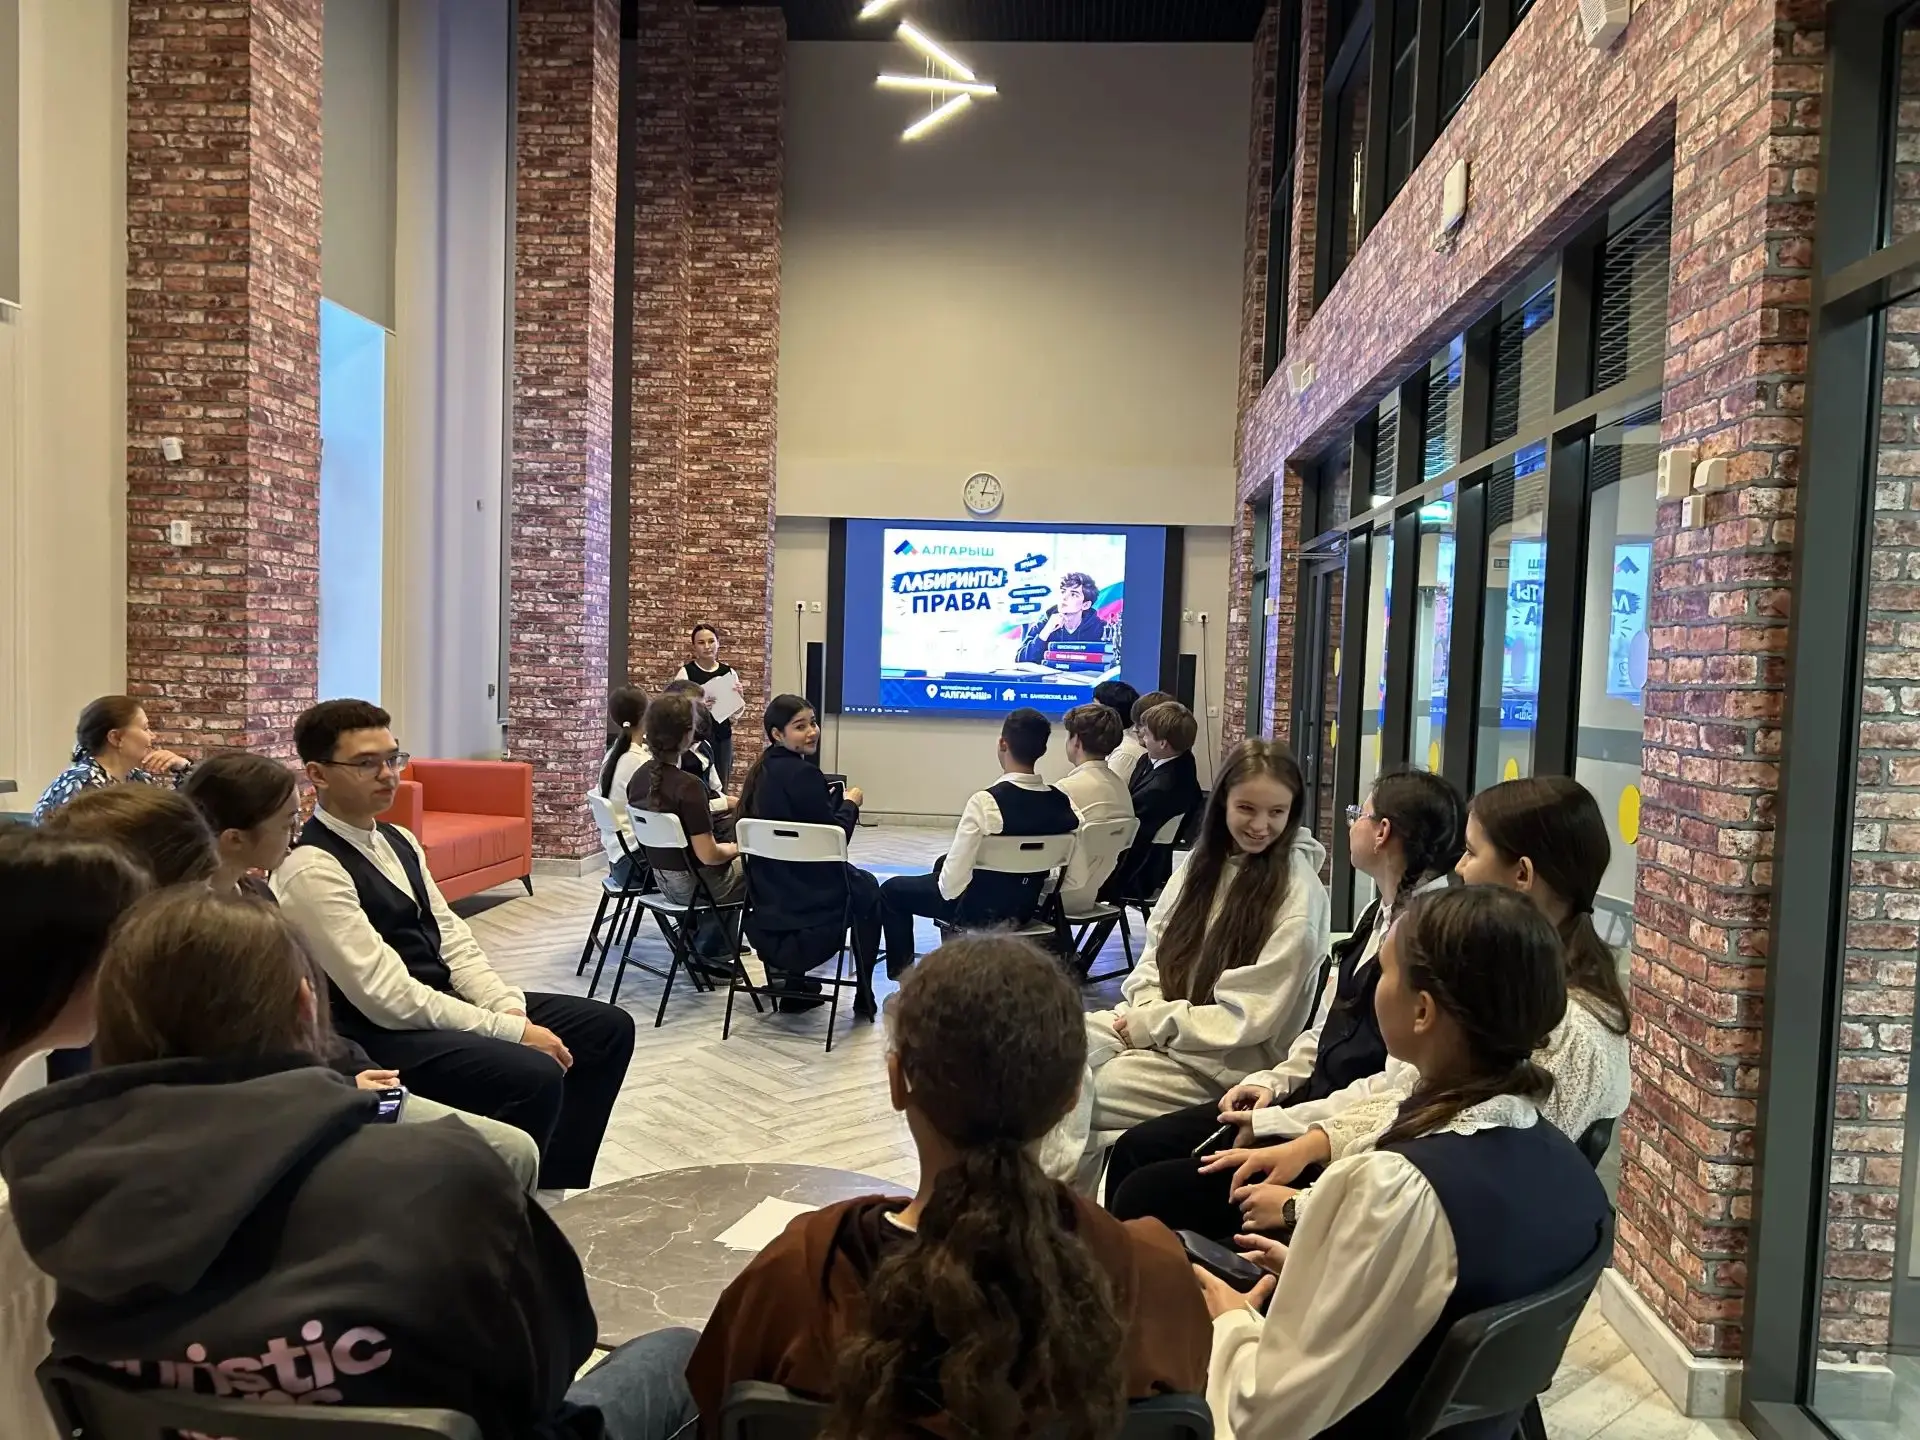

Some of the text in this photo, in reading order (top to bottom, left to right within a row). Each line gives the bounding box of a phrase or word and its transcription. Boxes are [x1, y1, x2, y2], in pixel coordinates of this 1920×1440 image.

[922, 545, 994, 556] АЛГАРЫШ
[899, 570, 1004, 592] ЛАБИРИНТЫ
[912, 592, 991, 614] ПРАВА
[939, 690, 992, 700] «АЛГАРЫШ»
